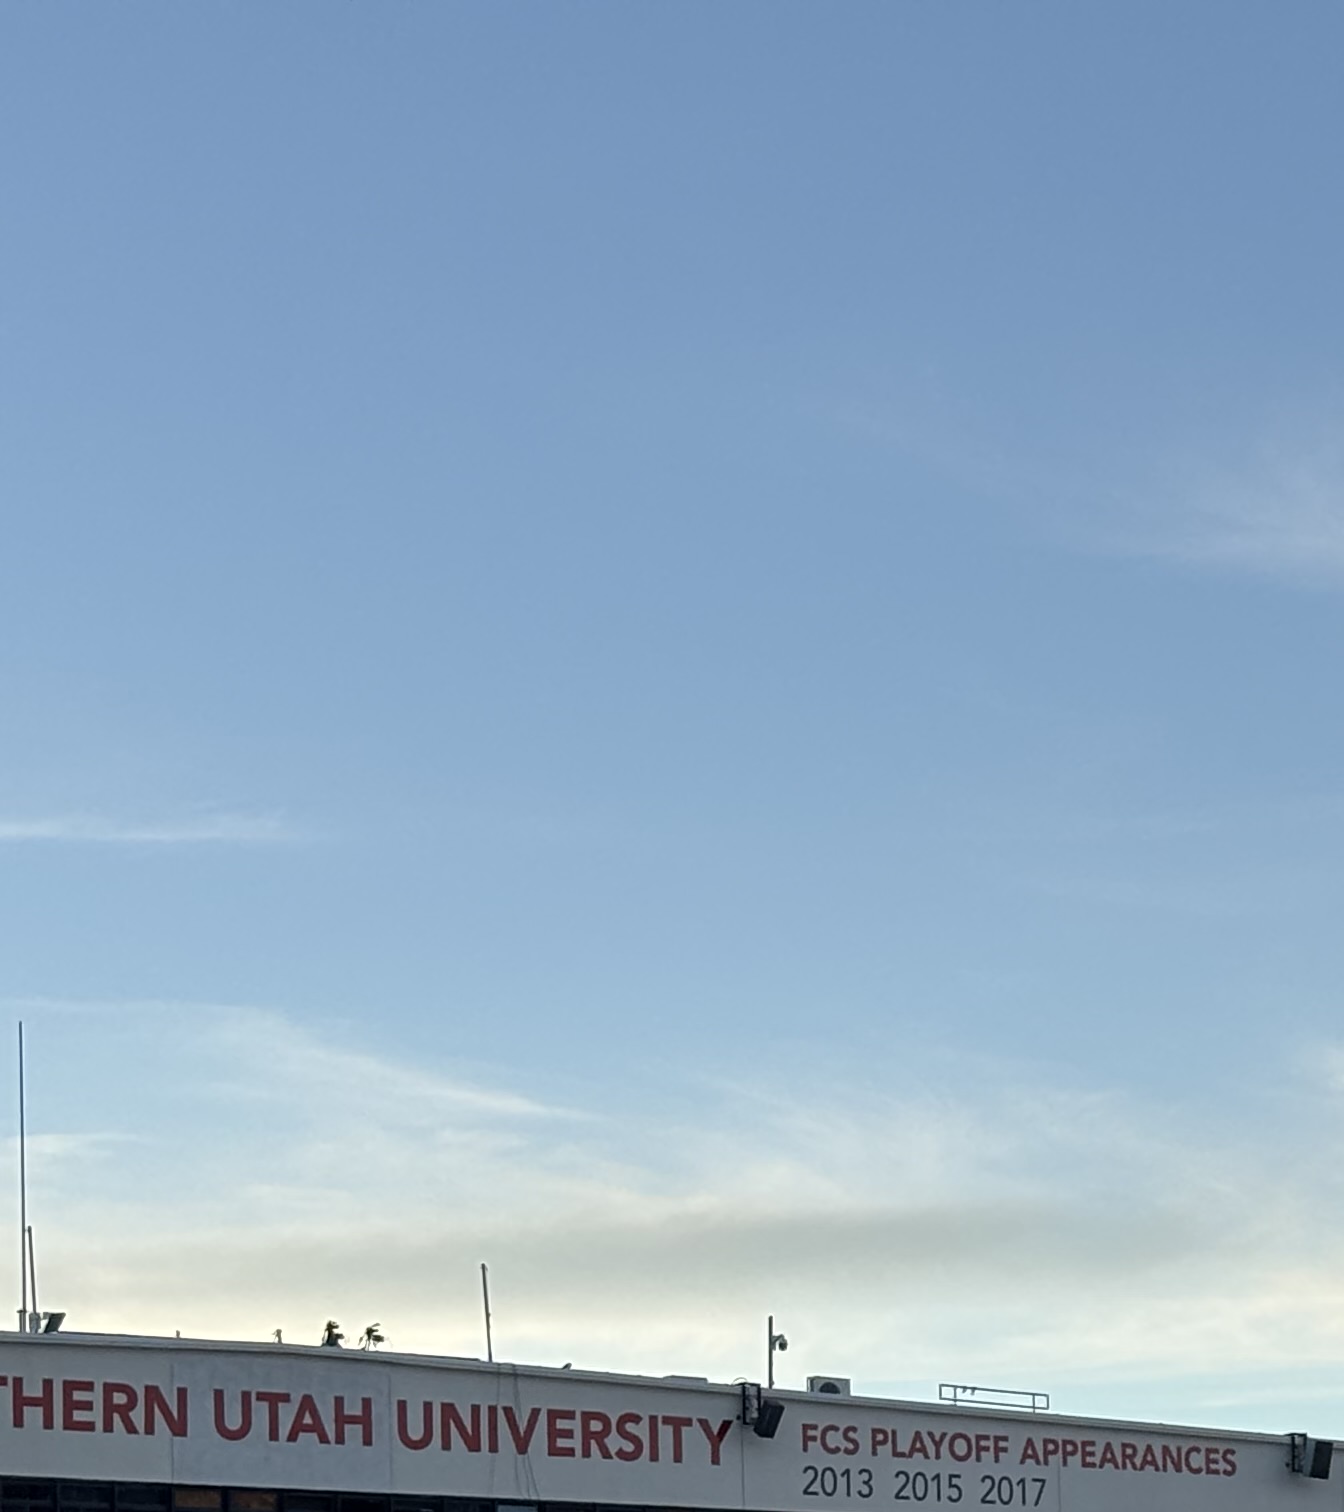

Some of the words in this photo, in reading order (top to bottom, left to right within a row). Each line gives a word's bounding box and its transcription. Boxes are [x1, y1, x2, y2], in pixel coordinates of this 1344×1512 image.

[213, 1388, 373, 1446] UTAH
[397, 1398, 733, 1466] UNIVERSITY
[801, 1423, 860, 1456] FCS
[871, 1427, 1009, 1464] PLAYOFF
[1019, 1437, 1238, 1477] APPEARANCES
[802, 1465, 873, 1499] 2013
[894, 1470, 963, 1503] 2015
[980, 1475, 1046, 1507] 2017
